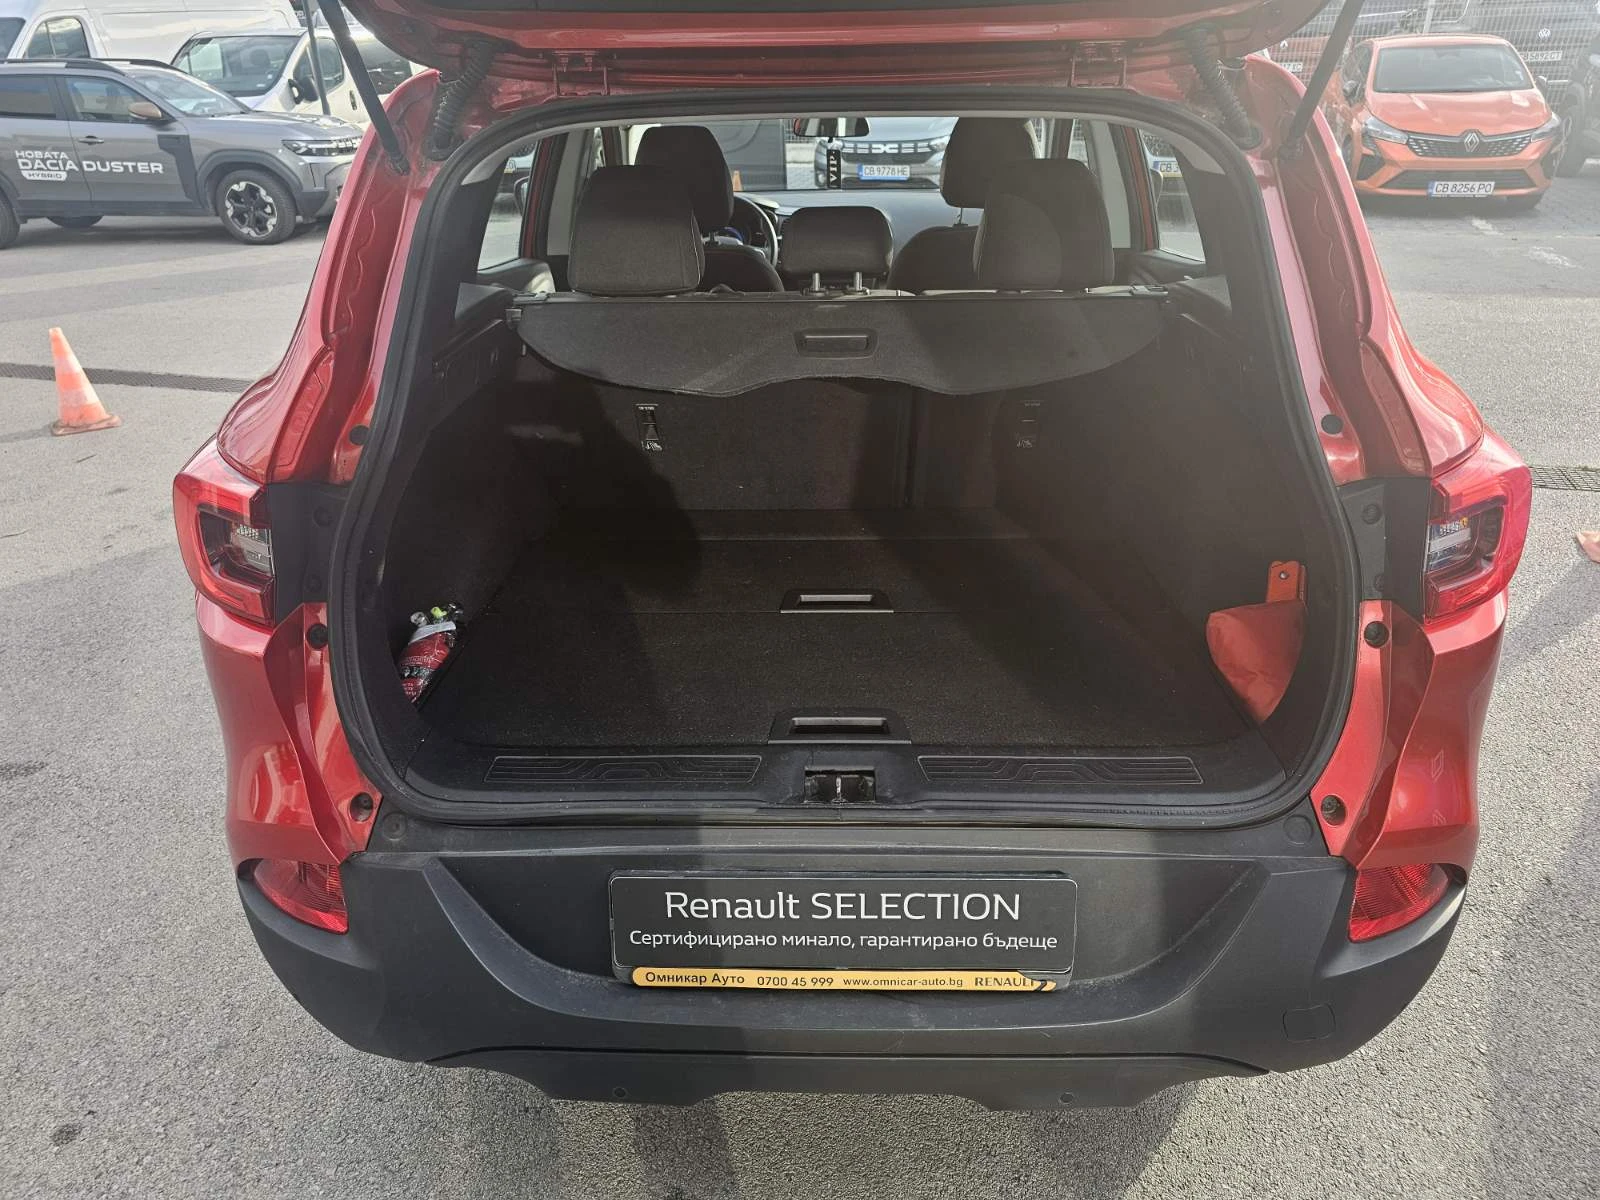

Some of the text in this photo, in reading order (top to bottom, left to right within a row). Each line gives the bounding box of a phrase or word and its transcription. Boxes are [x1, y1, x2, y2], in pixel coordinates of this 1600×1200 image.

[17, 158, 164, 174] DACIA DUSTER
[1435, 183, 1492, 193] CB 8256 PO
[665, 891, 1020, 920] Renault SELECTION
[629, 930, 1058, 950] Сертифицирано минало, гарантирано бъдеще
[645, 971, 707, 984] Омникар
[711, 973, 745, 985] Ауто
[757, 976, 788, 986] 0700
[791, 976, 807, 986] 45
[811, 976, 833, 986] 999
[843, 977, 963, 988] www.omnicar-auto.bg
